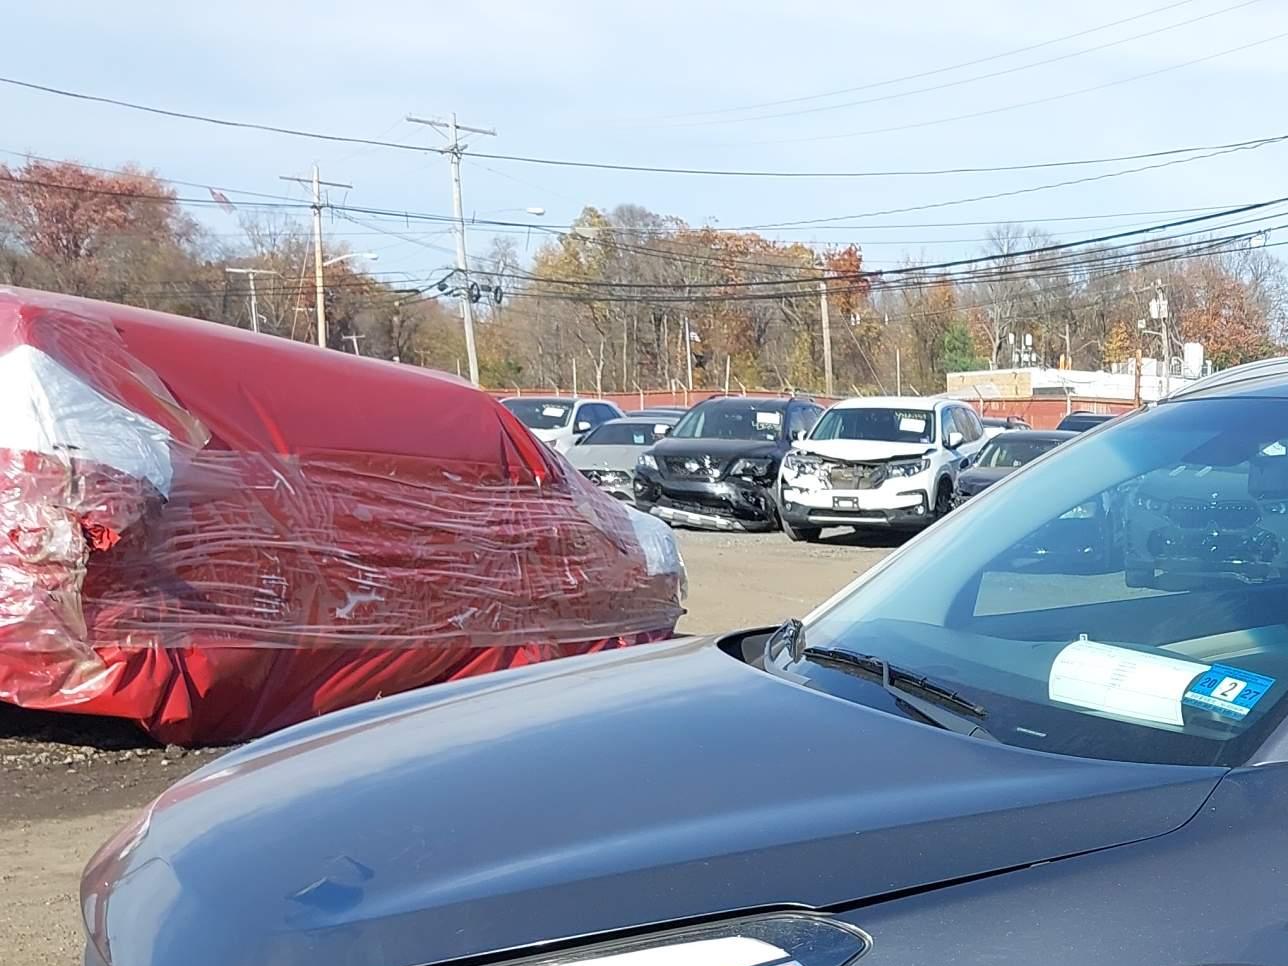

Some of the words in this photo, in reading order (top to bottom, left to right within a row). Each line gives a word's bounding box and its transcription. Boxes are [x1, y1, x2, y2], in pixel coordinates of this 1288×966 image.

[1199, 677, 1218, 690] 20
[1219, 681, 1238, 698] 2
[1240, 688, 1261, 701] 27
